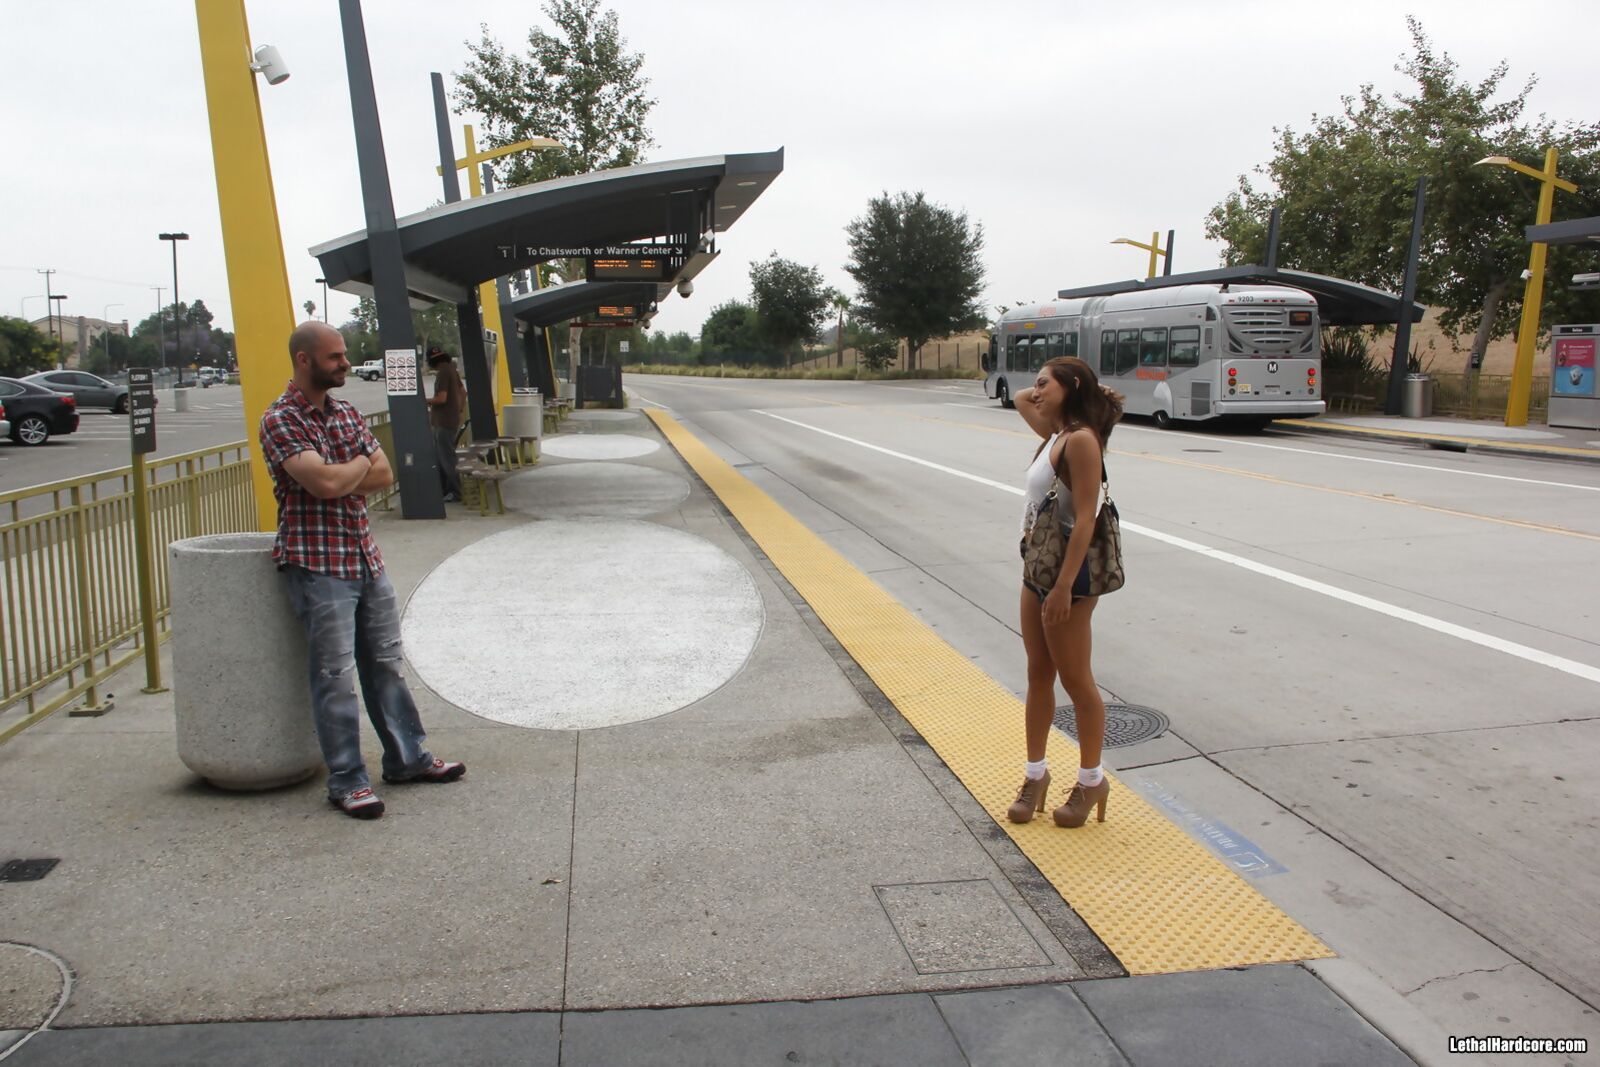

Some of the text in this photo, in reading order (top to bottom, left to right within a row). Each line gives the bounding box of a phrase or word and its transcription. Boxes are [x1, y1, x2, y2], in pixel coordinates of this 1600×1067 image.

[502, 249, 508, 258] 1
[527, 247, 537, 256] To
[539, 247, 592, 256] Chatsworth
[607, 246, 640, 255] Warner
[642, 246, 672, 255] Center
